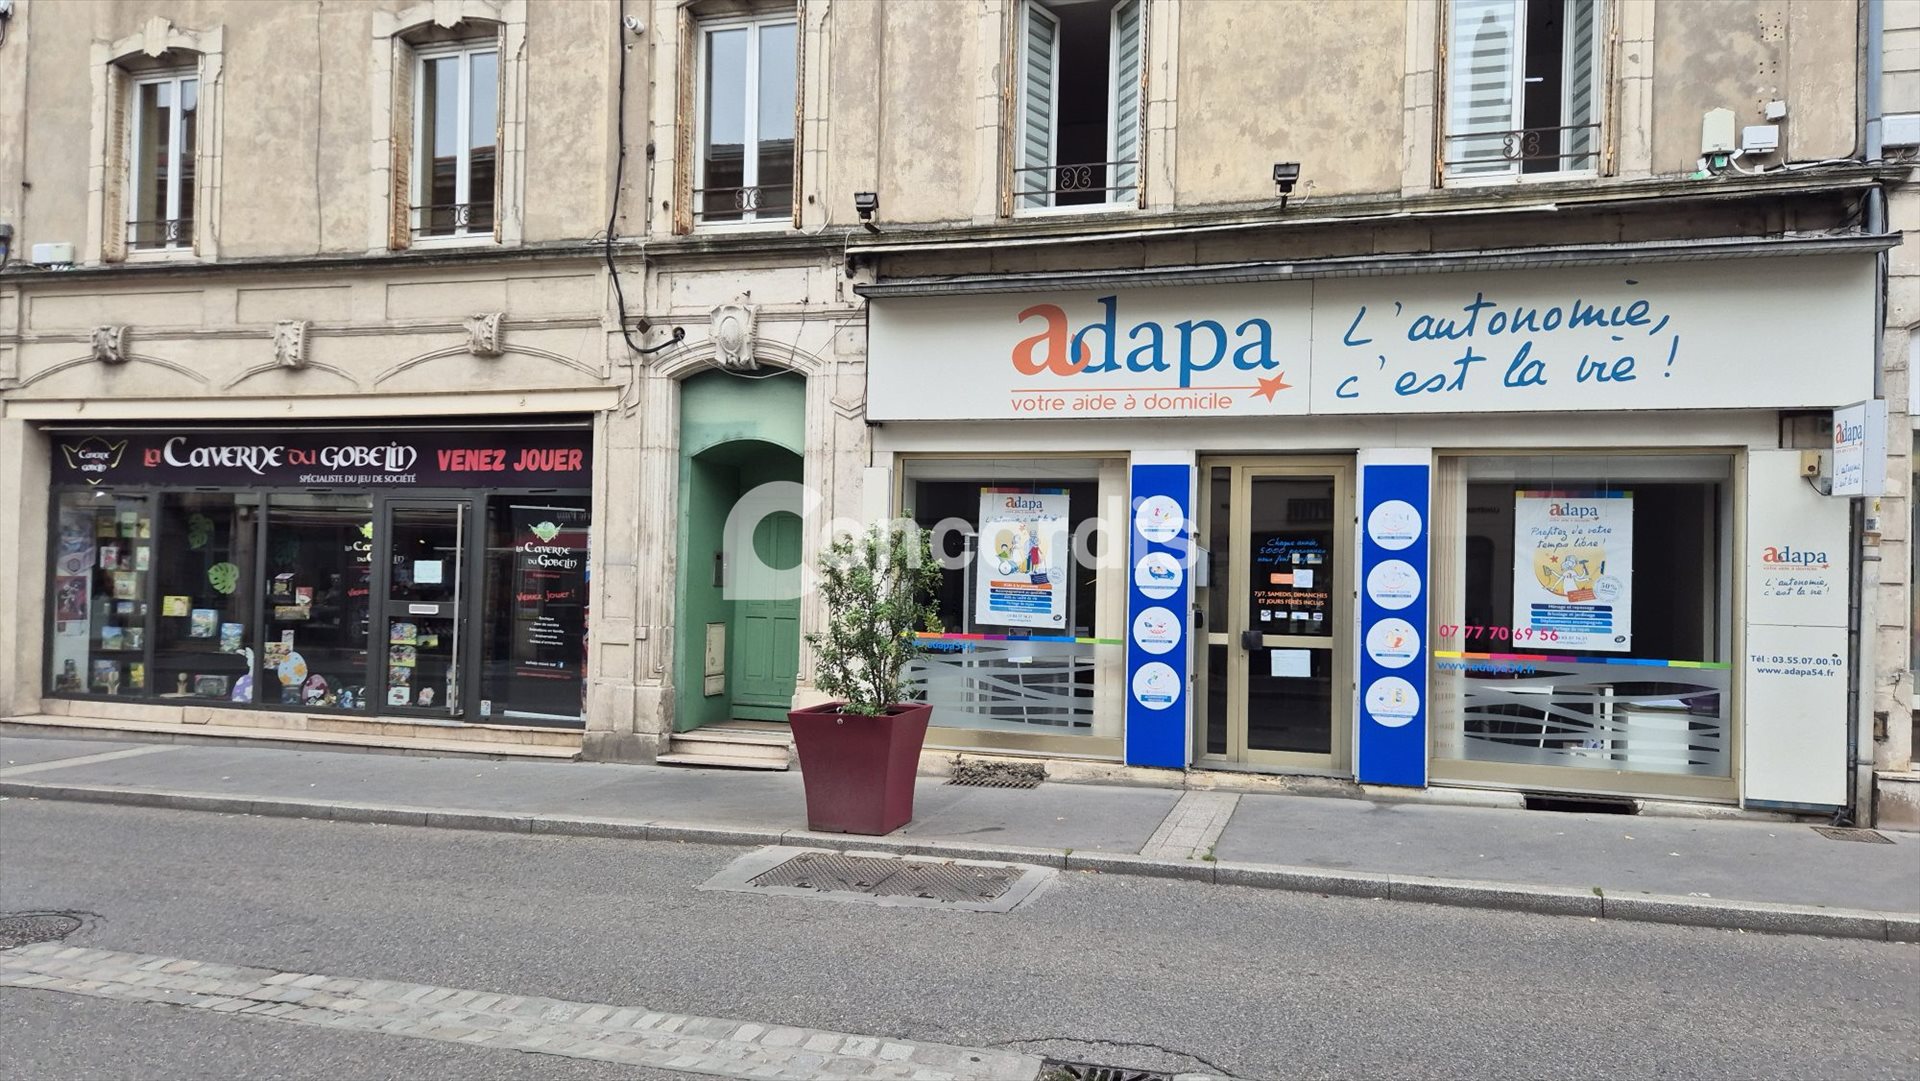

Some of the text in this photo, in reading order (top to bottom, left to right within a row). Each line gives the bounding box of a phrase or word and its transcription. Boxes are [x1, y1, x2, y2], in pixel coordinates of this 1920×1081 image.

[1012, 295, 1281, 388] adapa
[1503, 340, 1547, 387] la
[1576, 334, 1637, 383] vie
[1011, 393, 1233, 411] votre aide à domicile
[1836, 420, 1862, 446] adapa
[437, 449, 505, 472] VENEZ
[514, 448, 583, 472] JOUER
[299, 473, 417, 484] SPÉCIALISTE DU JEU DE SOCIÉTÉ
[1005, 496, 1043, 510] adapa
[1549, 502, 1598, 519] adapa
[1574, 537, 1599, 547] libre
[1763, 546, 1828, 566] adapa
[1440, 624, 1559, 641] 07 77 70 69 56
[1757, 668, 1834, 677] www.adapa54.fr
